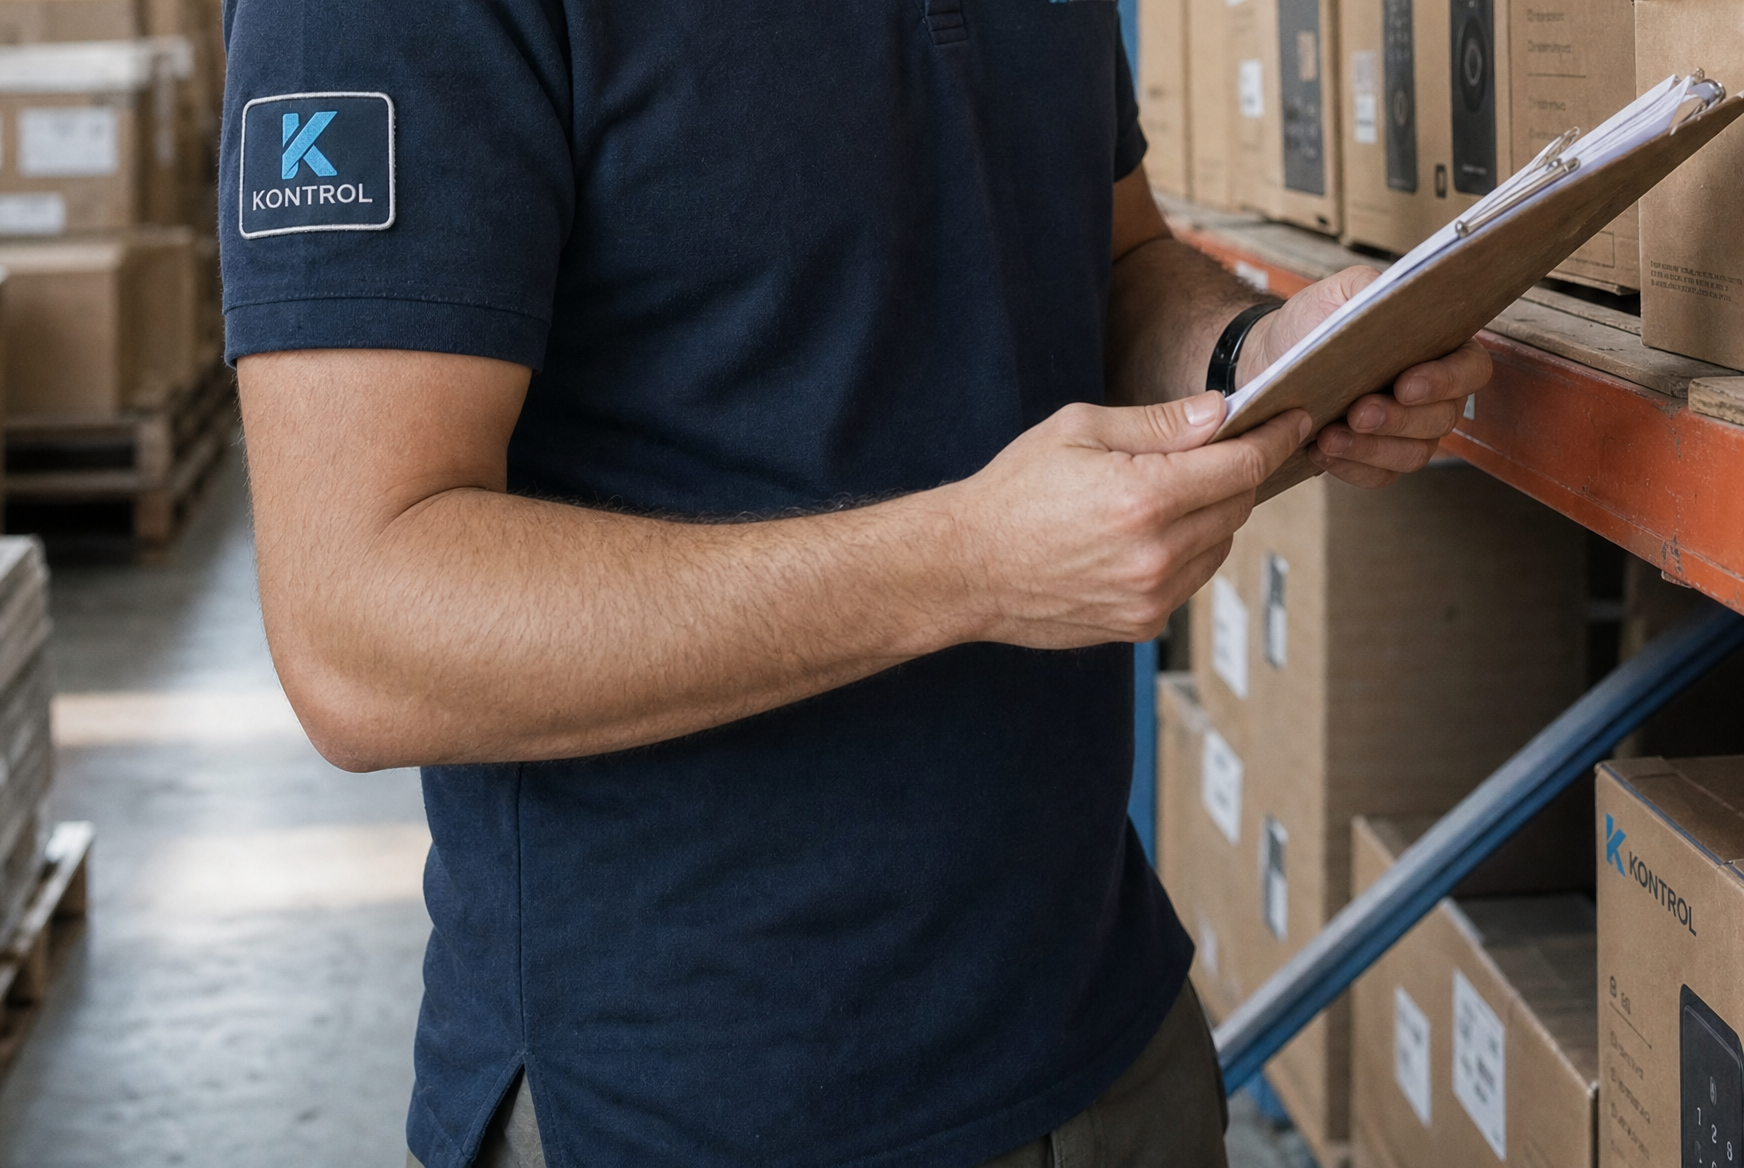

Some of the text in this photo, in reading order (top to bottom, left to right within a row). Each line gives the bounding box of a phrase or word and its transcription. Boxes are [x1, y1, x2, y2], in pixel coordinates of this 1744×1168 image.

[282, 110, 338, 180] K
[252, 183, 373, 211] KONTROL
[1606, 812, 1697, 937] K KONTROL
